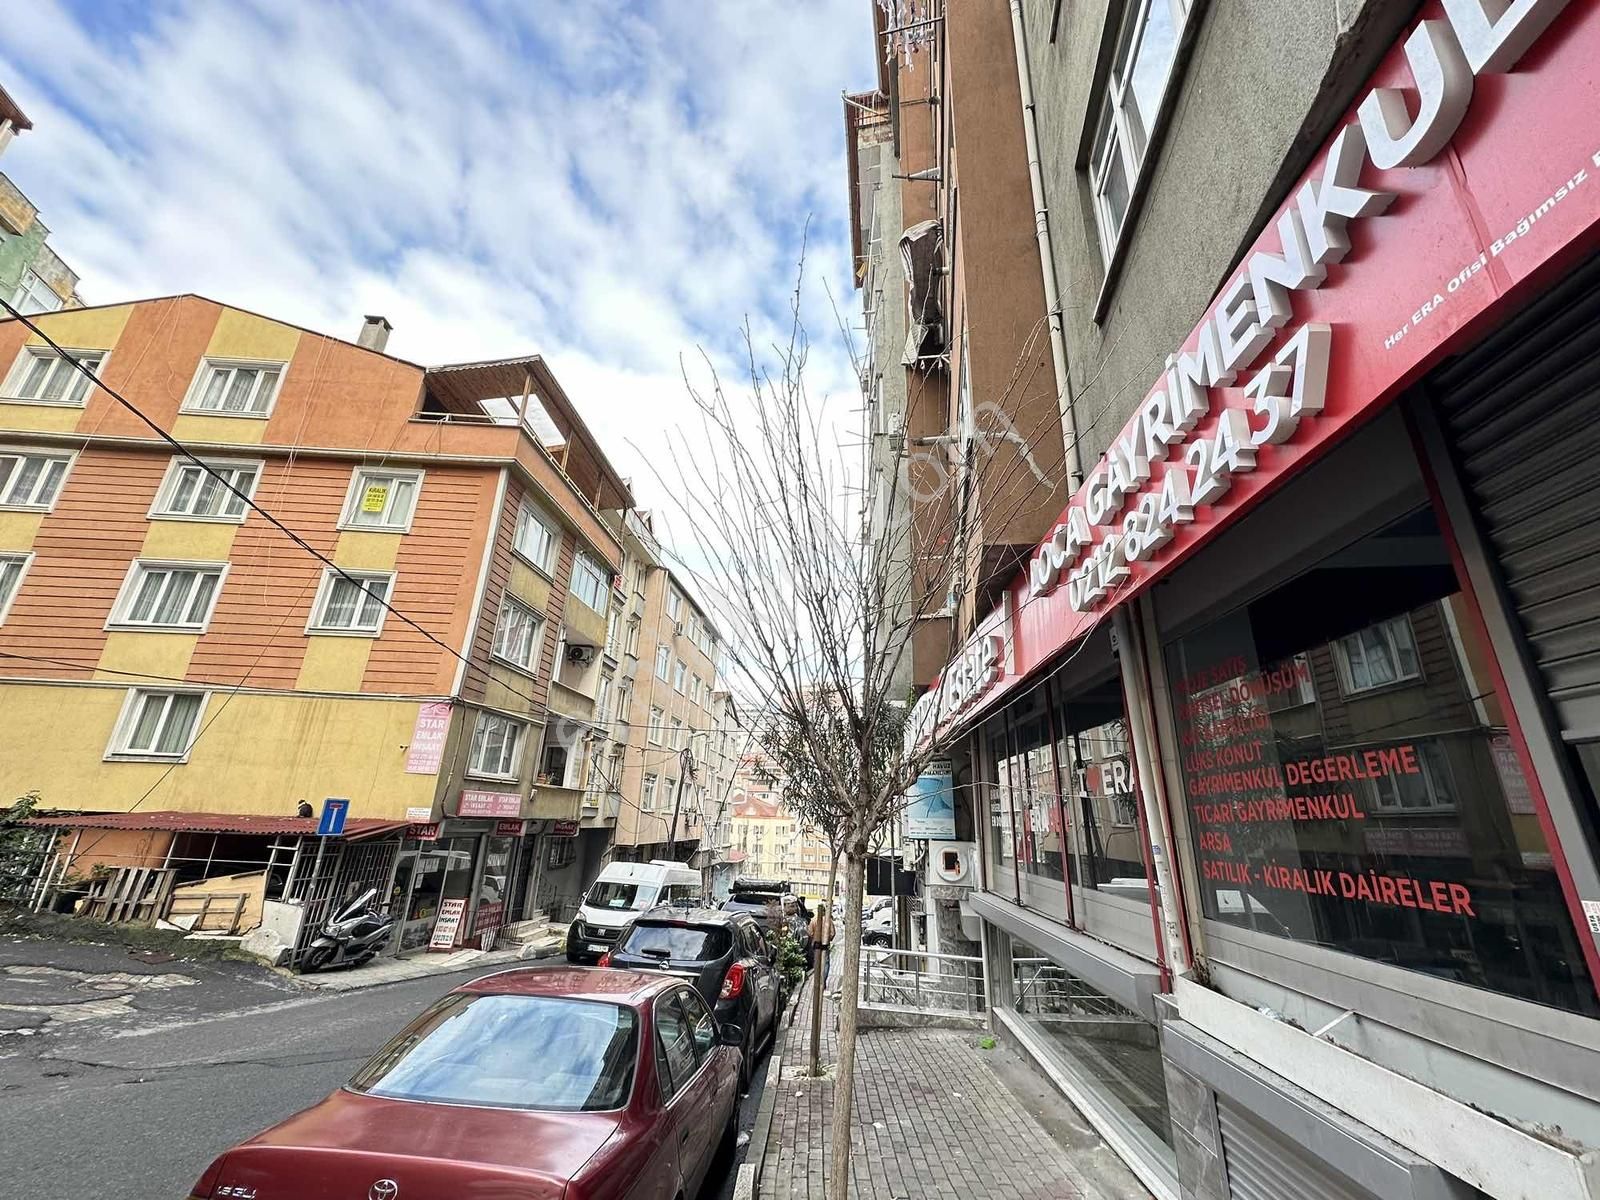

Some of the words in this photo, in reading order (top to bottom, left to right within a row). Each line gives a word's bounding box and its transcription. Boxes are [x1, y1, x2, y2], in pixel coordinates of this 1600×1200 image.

[1384, 323, 1409, 350] Her
[1411, 294, 1445, 327] ERA
[1447, 252, 1488, 293] Ofisi
[1489, 168, 1588, 257] Bağımsız
[1069, 533, 1130, 612] 0212
[1122, 468, 1194, 562] 824
[1186, 408, 1257, 505] 24
[1244, 322, 1331, 446] 37
[419, 718, 446, 729] STAR
[416, 730, 443, 741] EMLAK
[1216, 741, 1263, 767] KONUT
[409, 824, 436, 836] STAR
[1200, 831, 1233, 852] ARSA
[1203, 860, 1251, 885] SATILIK
[1263, 858, 1339, 897] KİRALIK
[1338, 868, 1477, 917] DAİRELER
[441, 909, 461, 917] EMLAK
[443, 901, 463, 909] STAR
